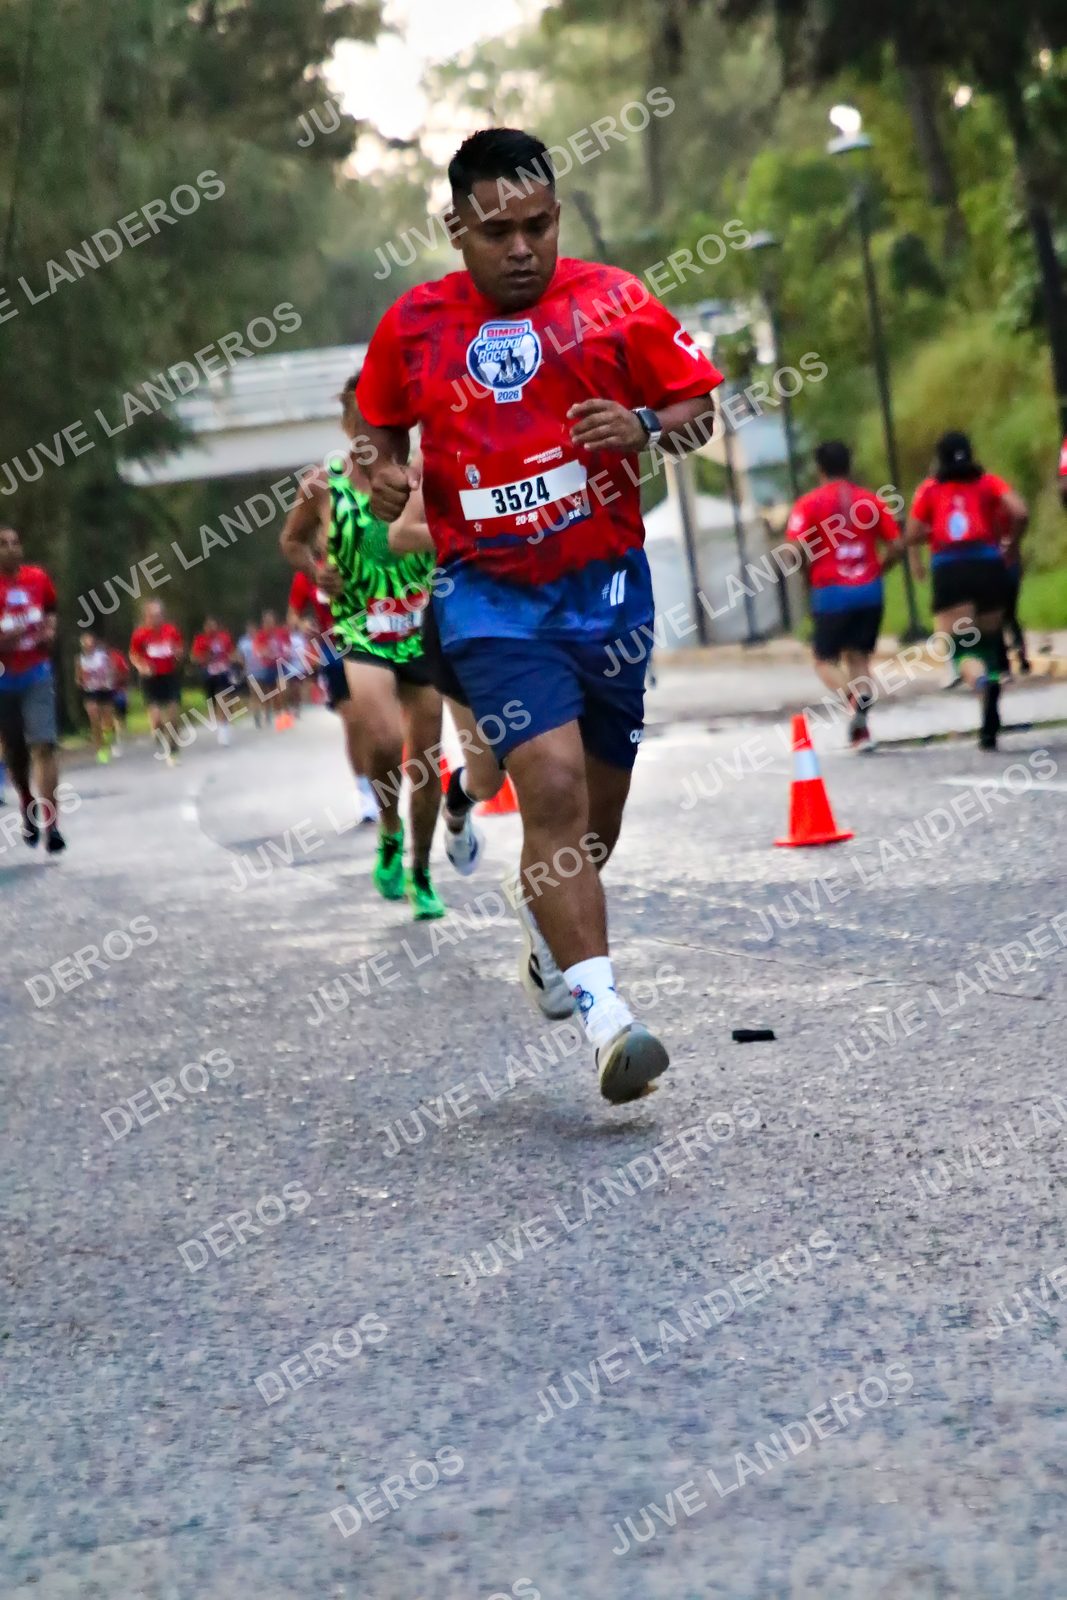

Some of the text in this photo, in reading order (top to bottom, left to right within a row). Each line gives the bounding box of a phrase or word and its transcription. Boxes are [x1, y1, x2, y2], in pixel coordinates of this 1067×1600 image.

[487, 328, 524, 337] BIMBO
[485, 336, 523, 351] Global
[478, 350, 508, 363] Race
[498, 390, 519, 401] 2026
[491, 476, 550, 514] 3524
